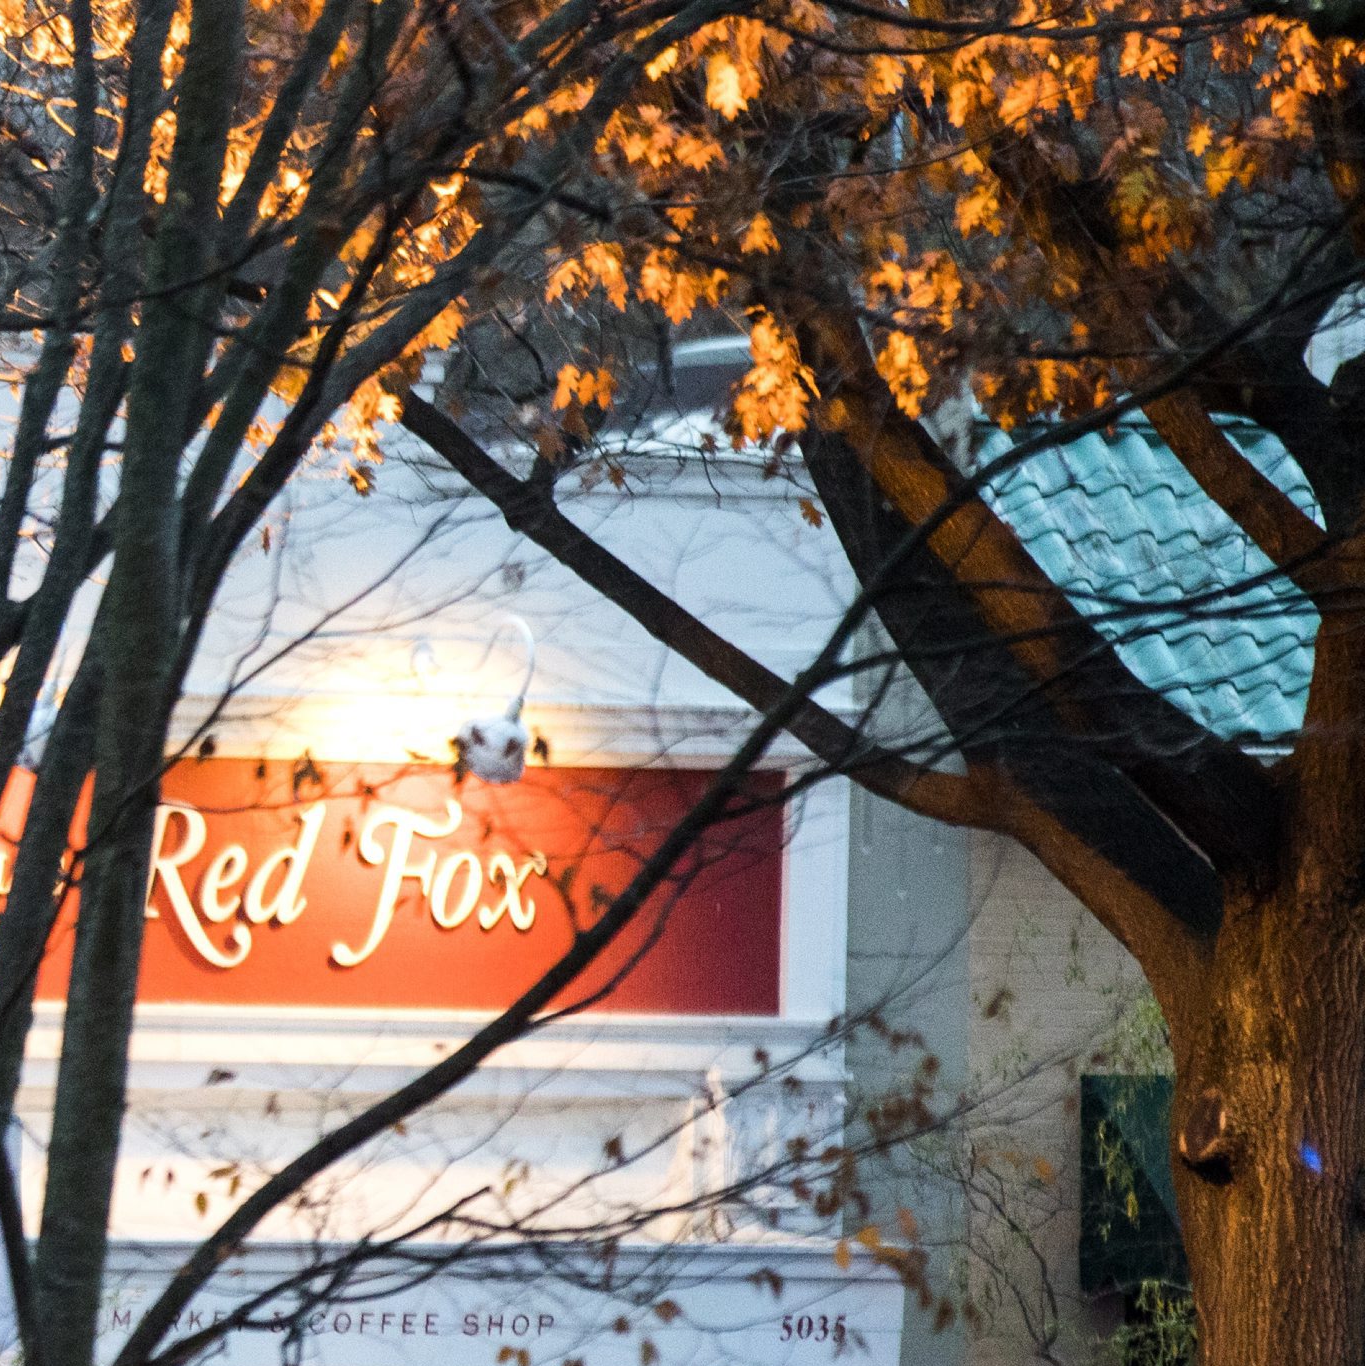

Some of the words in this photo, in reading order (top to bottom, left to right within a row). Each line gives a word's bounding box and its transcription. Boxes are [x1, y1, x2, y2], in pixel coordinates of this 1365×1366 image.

[144, 800, 327, 968] Red
[330, 799, 548, 968] Fox
[309, 1311, 440, 1336] COFFEE
[463, 1311, 556, 1337] SHOP
